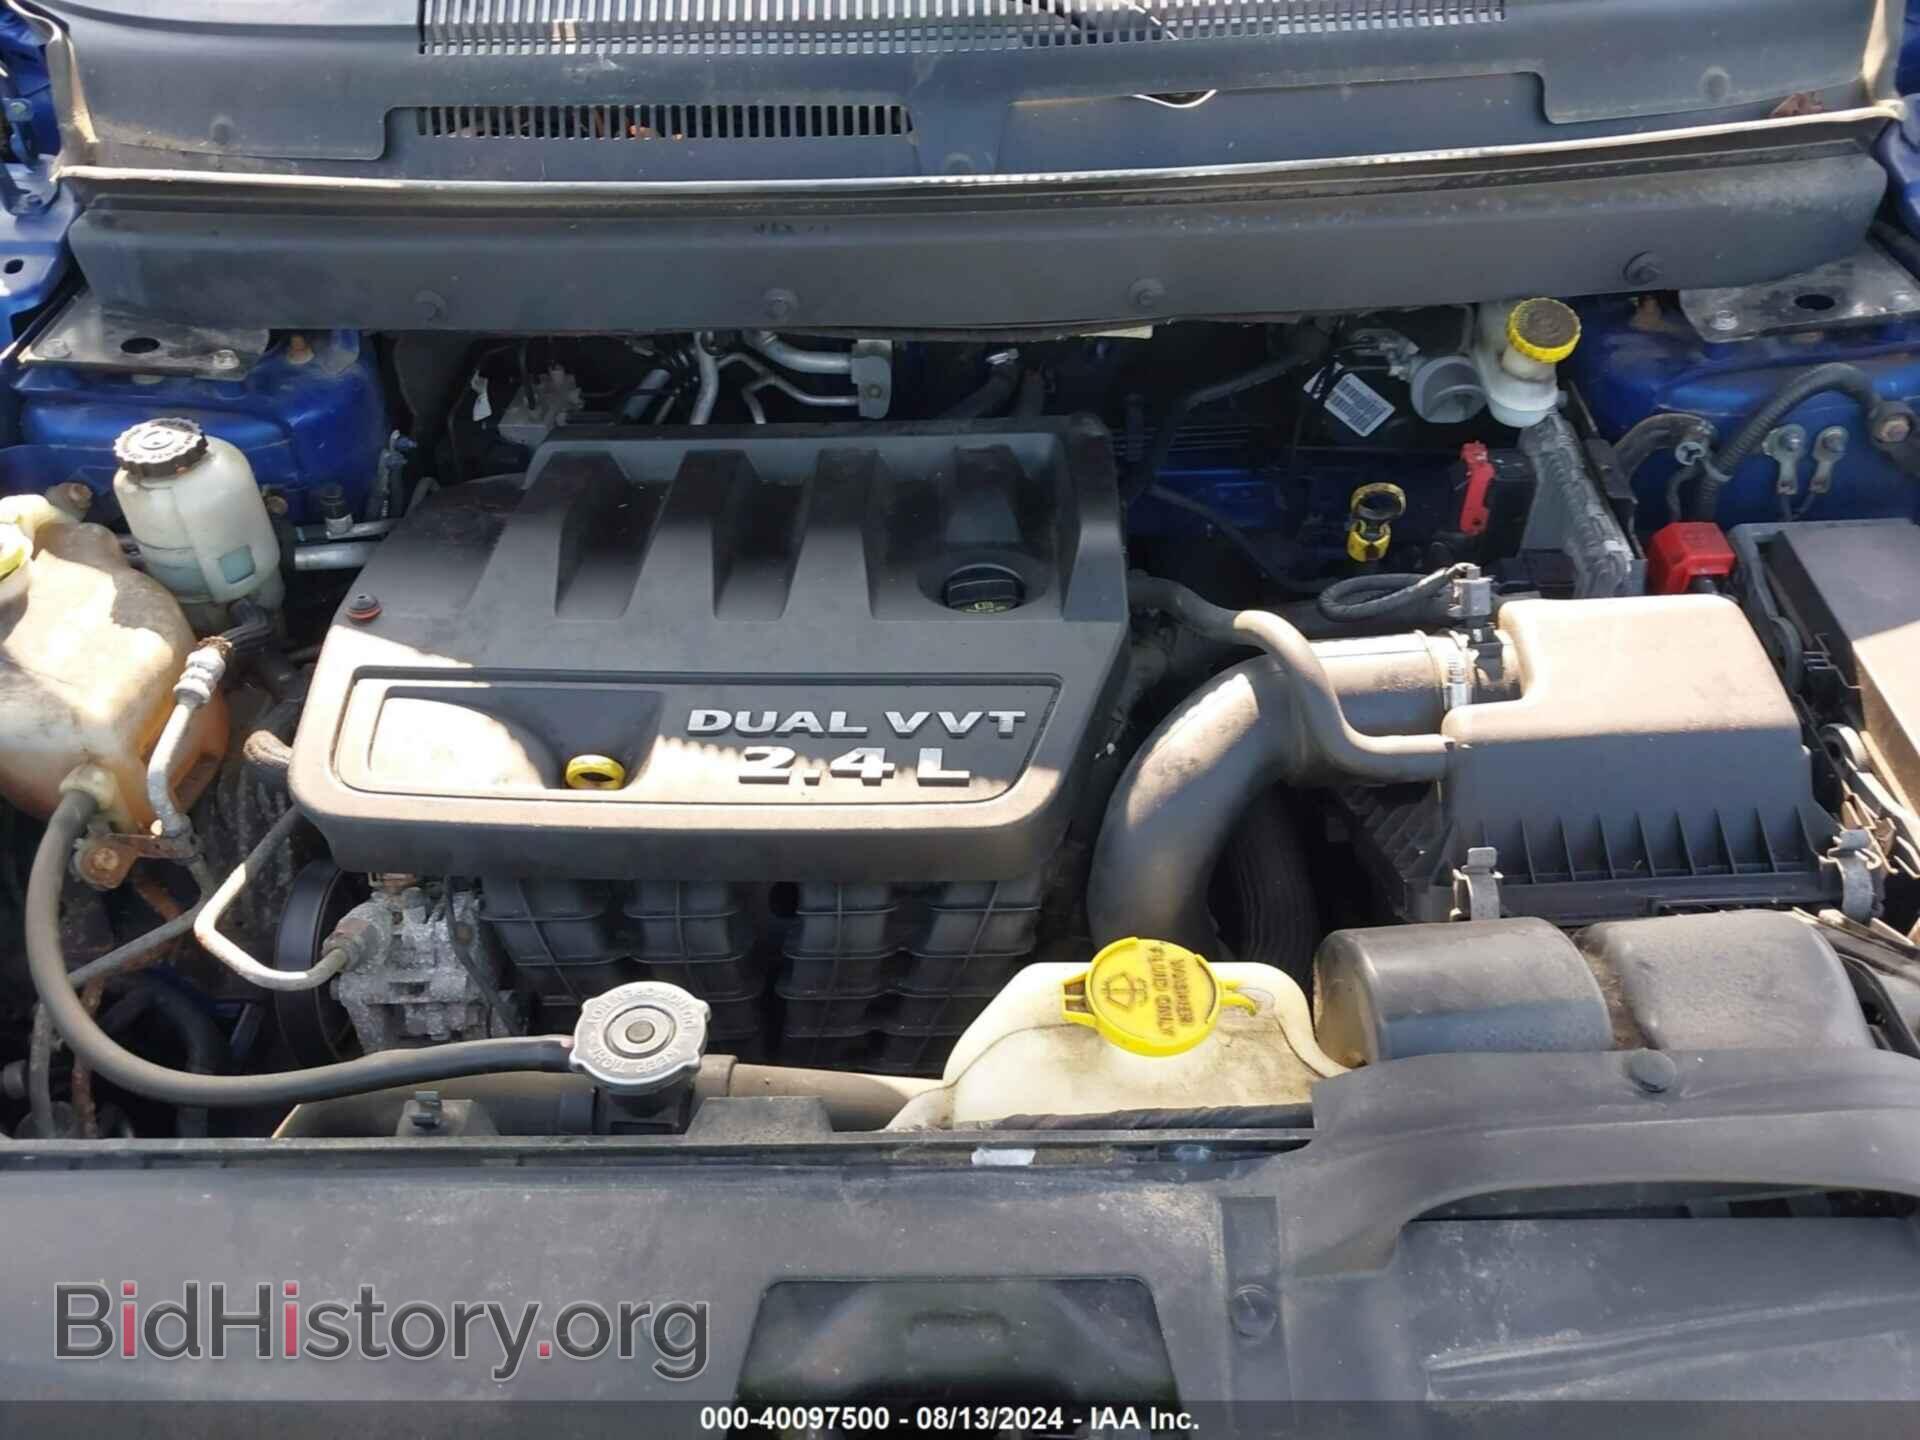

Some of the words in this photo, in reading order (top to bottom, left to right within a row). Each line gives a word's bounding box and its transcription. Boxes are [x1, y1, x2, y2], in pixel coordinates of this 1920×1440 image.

[687, 709, 868, 738] DUAL
[884, 710, 1026, 738] VVT
[1148, 946, 1169, 993] FLUID
[1169, 958, 1194, 1027] WASHER
[1155, 994, 1177, 1037] ONLY
